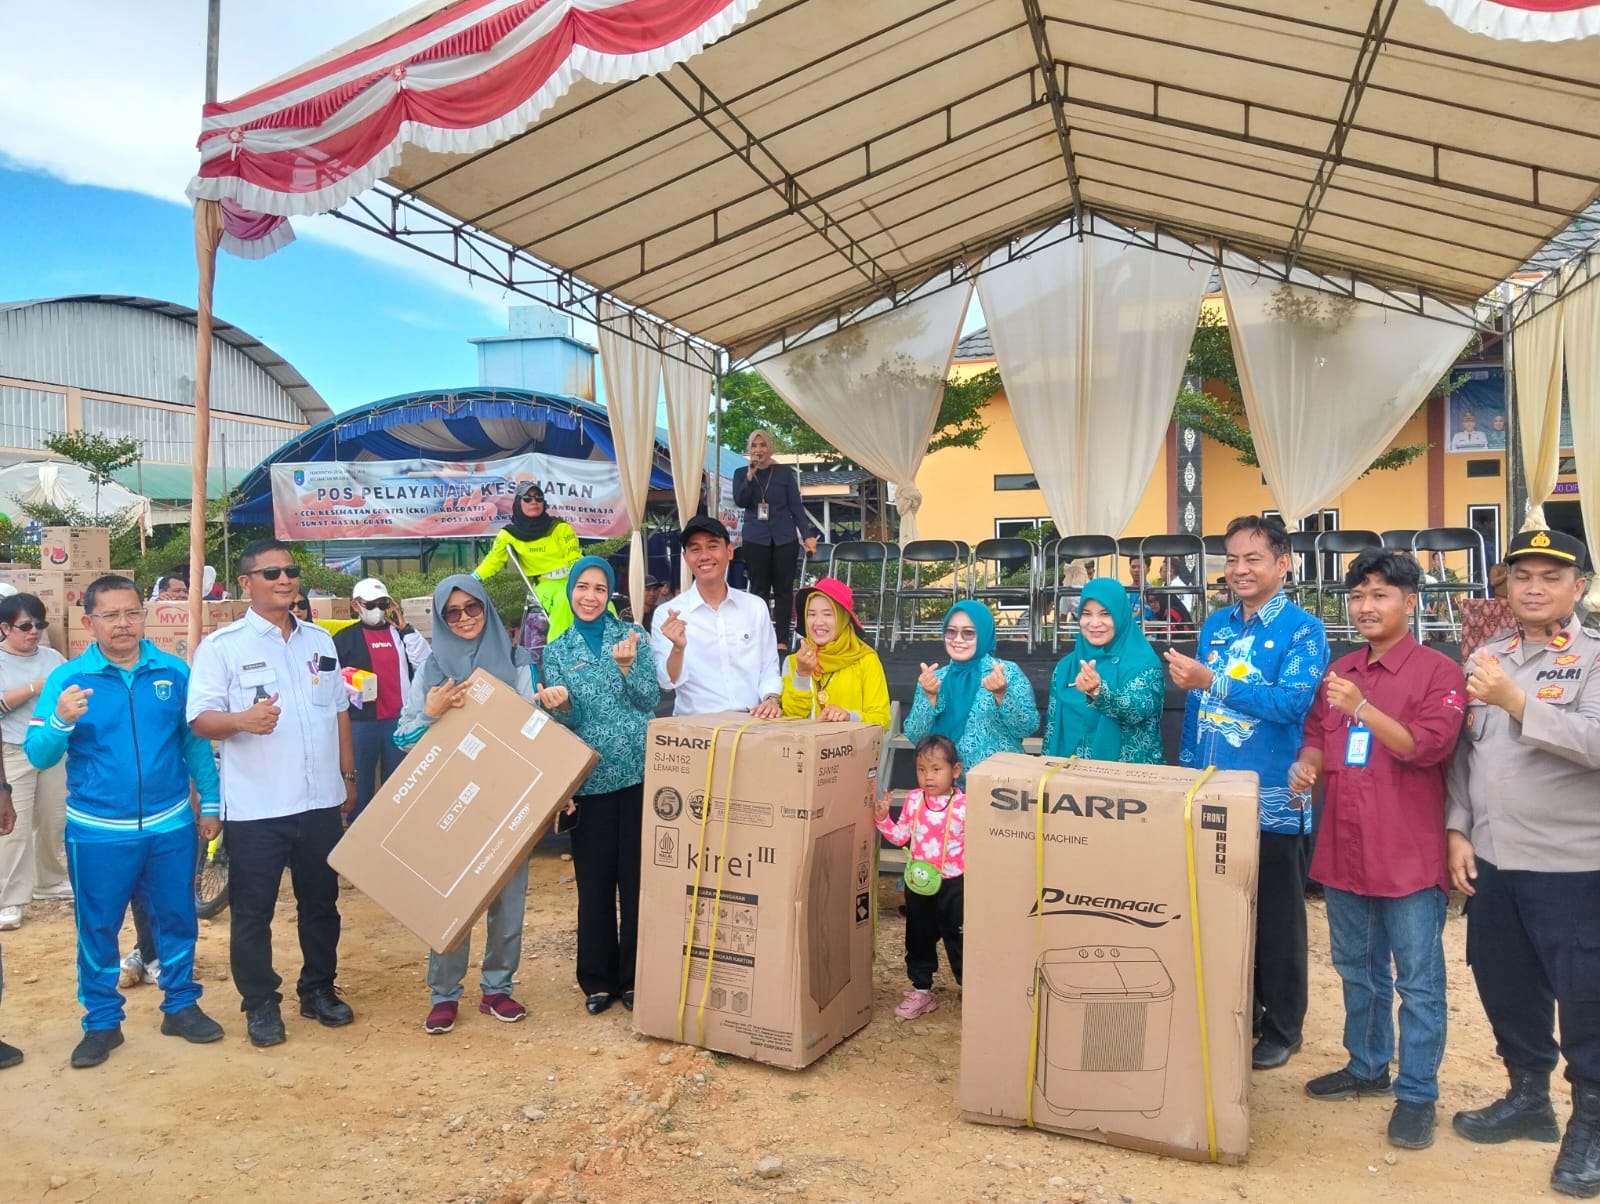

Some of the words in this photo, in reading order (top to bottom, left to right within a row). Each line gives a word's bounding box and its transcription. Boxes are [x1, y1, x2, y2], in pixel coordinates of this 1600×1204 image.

[317, 487, 353, 501] POS
[361, 484, 472, 500] PELAYANAN
[481, 480, 594, 499] KESATAN
[319, 508, 371, 516] KESEHATAN
[301, 519, 328, 527] SUNAT
[1536, 668, 1581, 681] POLRI
[655, 734, 712, 750] SHARP
[654, 752, 691, 765] SJ-N162
[820, 744, 853, 760] SHARP
[990, 787, 1148, 821] SHARP
[439, 813, 454, 831] LED
[452, 801, 463, 813] TV
[1202, 812, 1226, 824] FRONT
[989, 827, 1036, 841] WASHING
[1041, 832, 1089, 845] MACHINE
[687, 843, 752, 878] kirei
